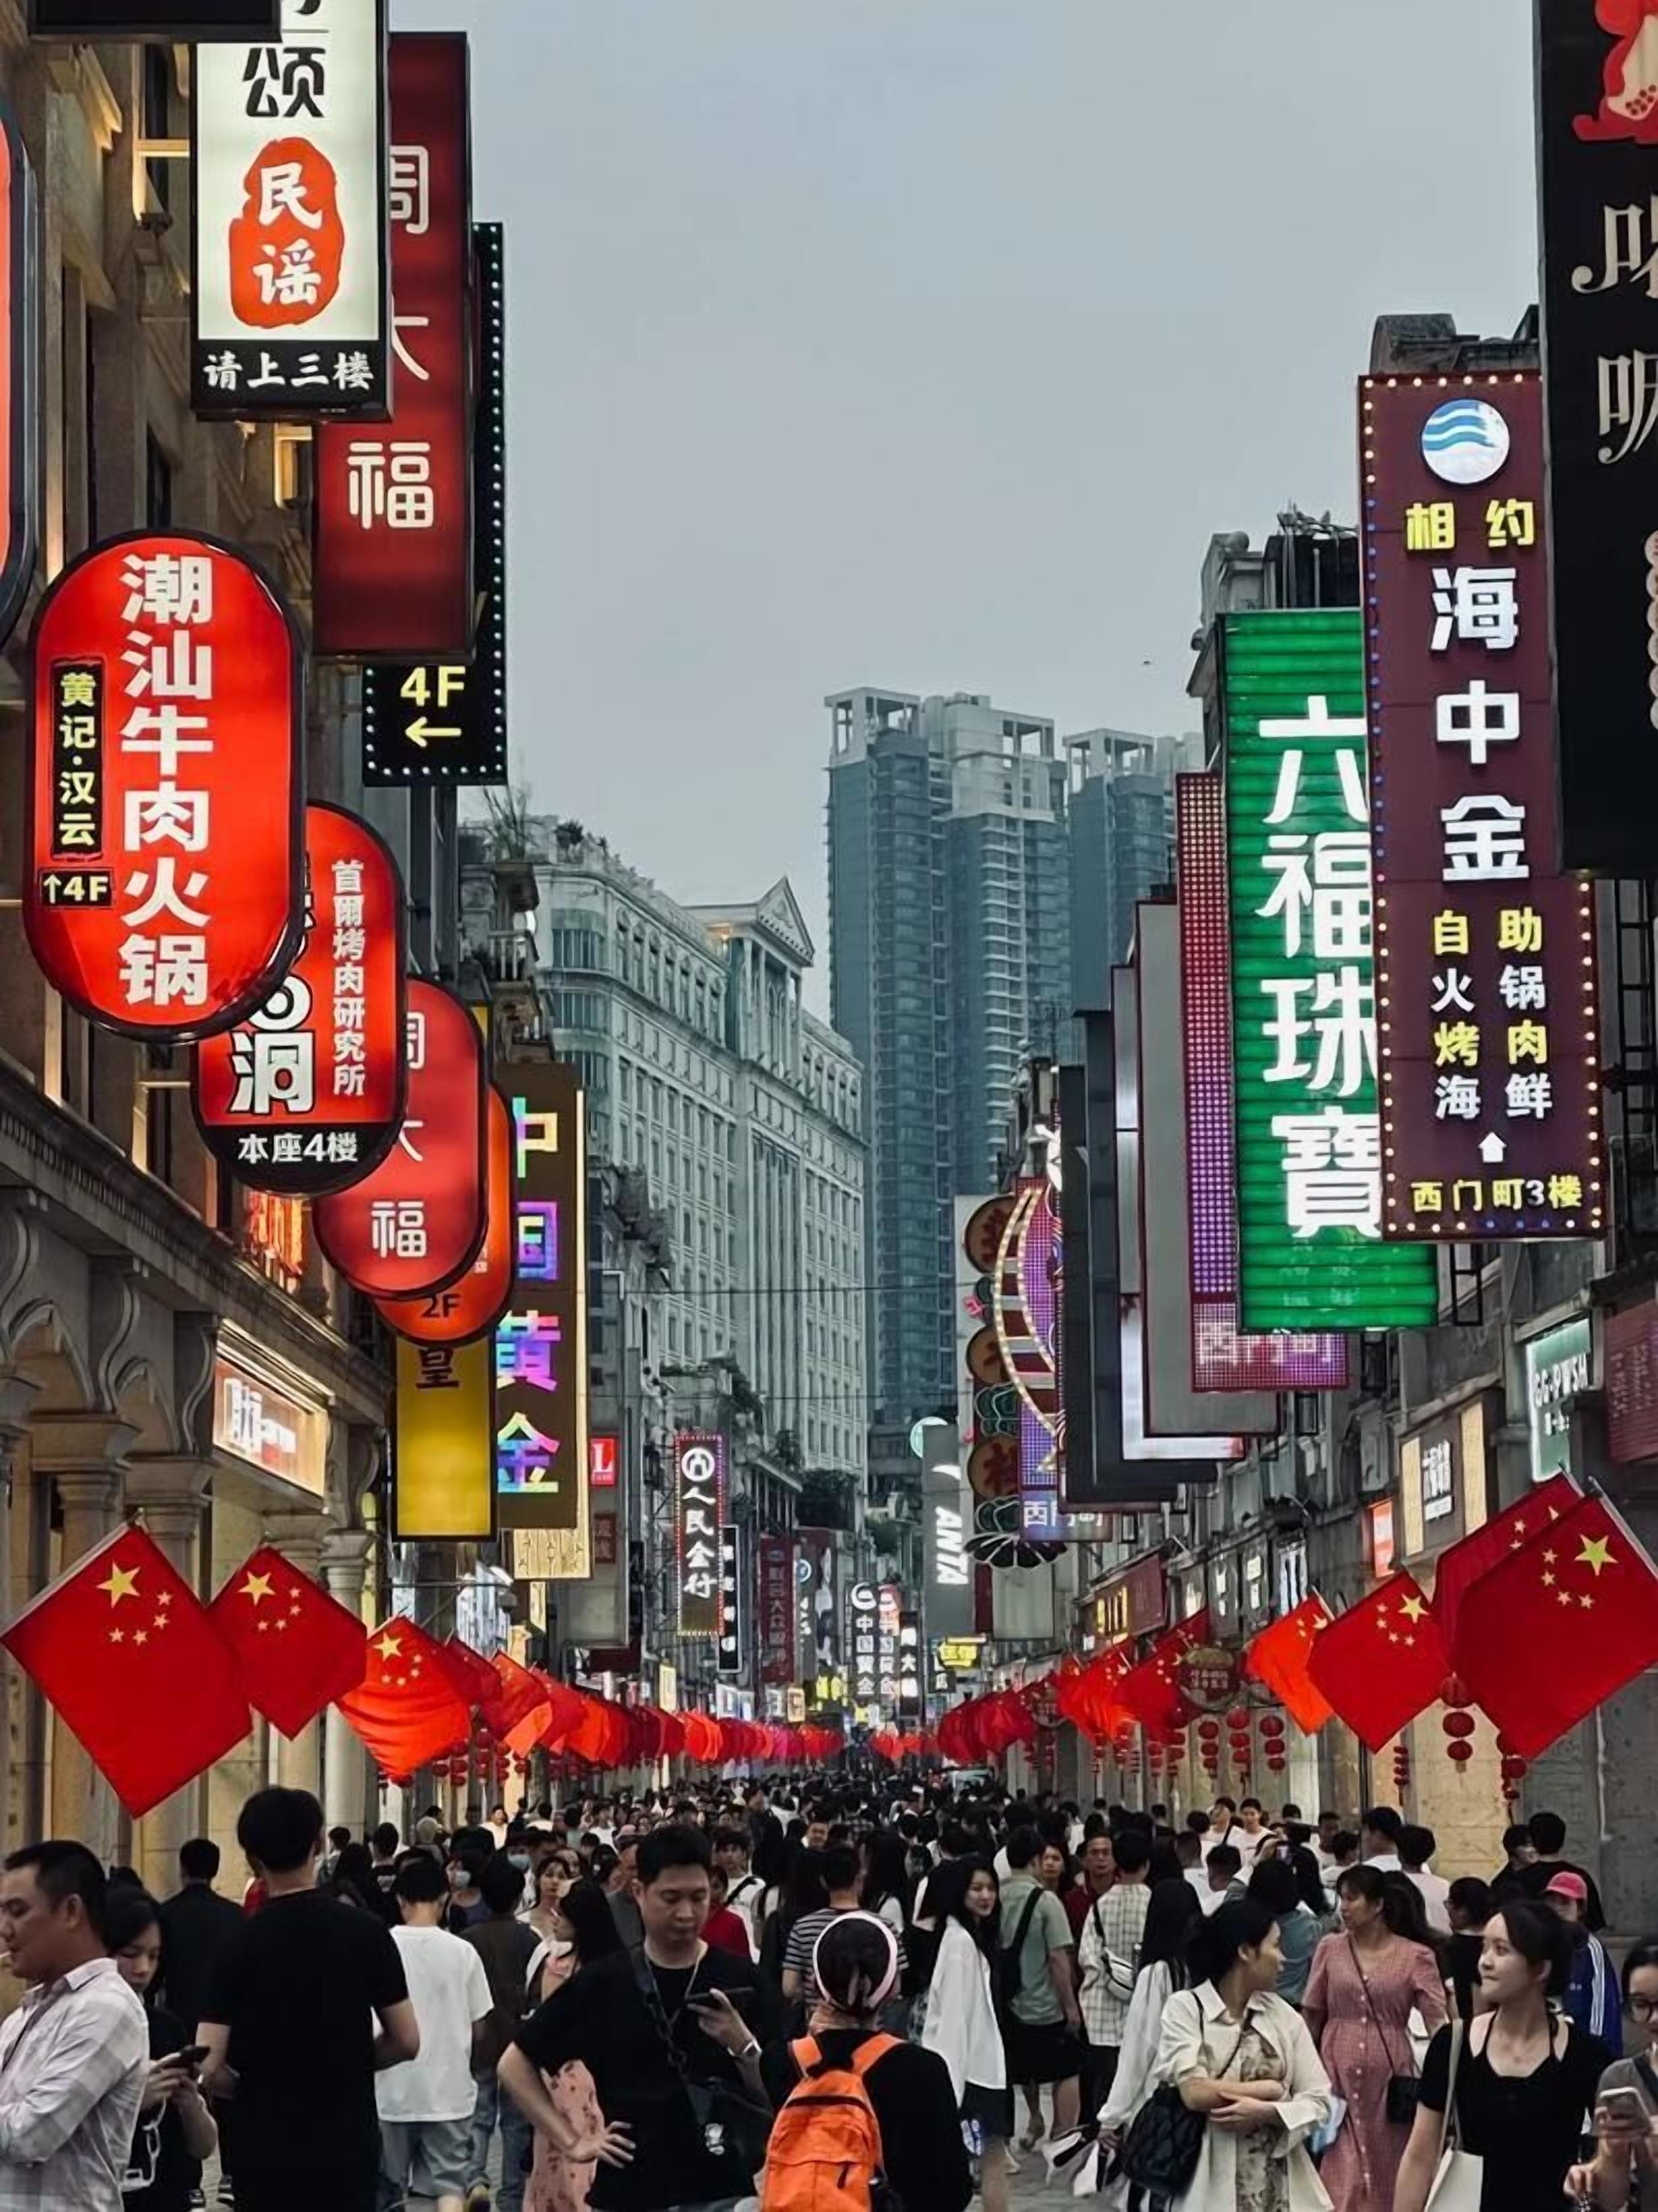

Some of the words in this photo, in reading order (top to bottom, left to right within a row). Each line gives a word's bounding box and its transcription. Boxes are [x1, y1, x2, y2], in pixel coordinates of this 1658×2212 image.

[252, 162, 323, 305] 民谣
[202, 351, 374, 392] 请上三楼
[1405, 498, 1535, 551] 相约
[400, 666, 466, 707] 4F
[1430, 567, 1530, 882] 海中金
[119, 553, 214, 1006] 潮汕牛肉火锅
[64, 876, 109, 903] 4F
[238, 1132, 358, 1164] 本座4楼
[1410, 1174, 1582, 1213] 西门町3楼
[421, 1294, 460, 1317] 2F
[934, 1505, 969, 1585] ANTA
